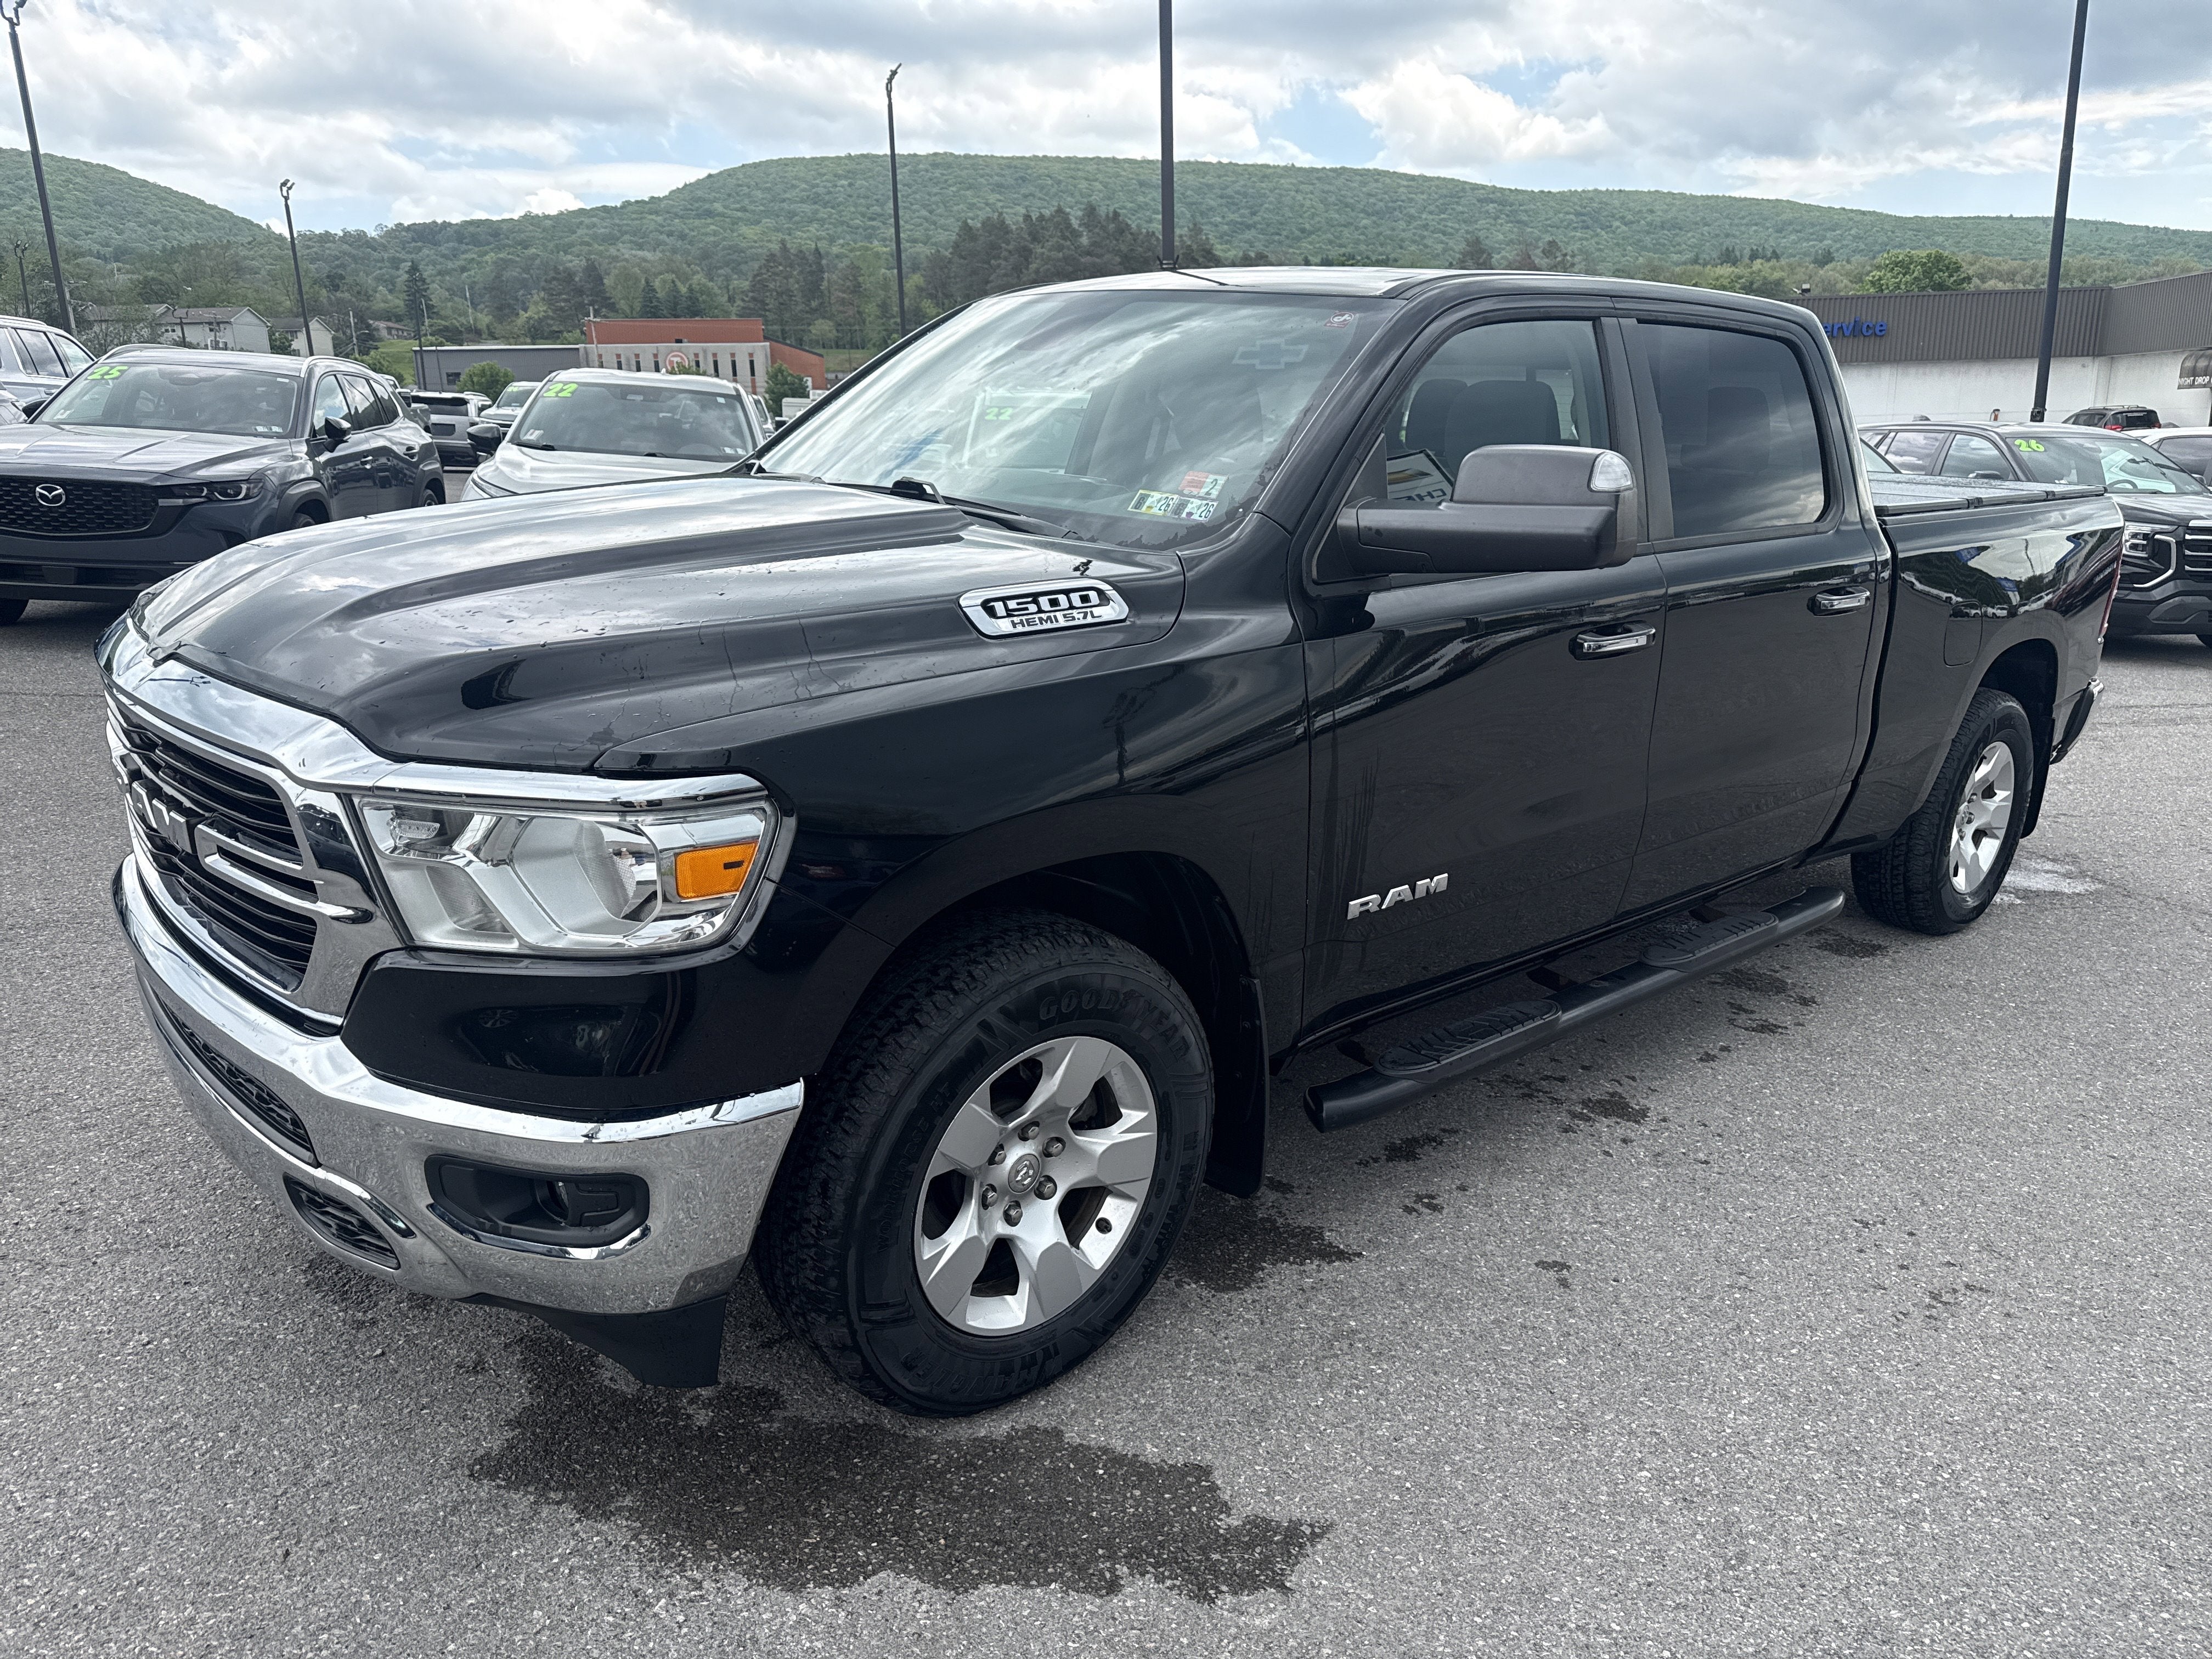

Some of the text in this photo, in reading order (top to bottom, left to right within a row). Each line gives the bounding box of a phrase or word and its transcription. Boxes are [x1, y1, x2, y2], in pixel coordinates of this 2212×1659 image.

[87, 366, 128, 380] 25
[2194, 376, 2210, 385] DROP
[543, 383, 578, 397] 22
[984, 407, 1013, 420] 22
[2014, 439, 2045, 452] 26
[1205, 478, 1218, 496] 2
[1134, 496, 1175, 512] 6 26
[1198, 503, 1215, 518] 26
[986, 590, 1101, 617] 1500
[1010, 609, 1102, 629] HEMI 5.7L
[1347, 873, 1448, 920] RAM
[1040, 988, 1190, 1062] GOODYEAR
